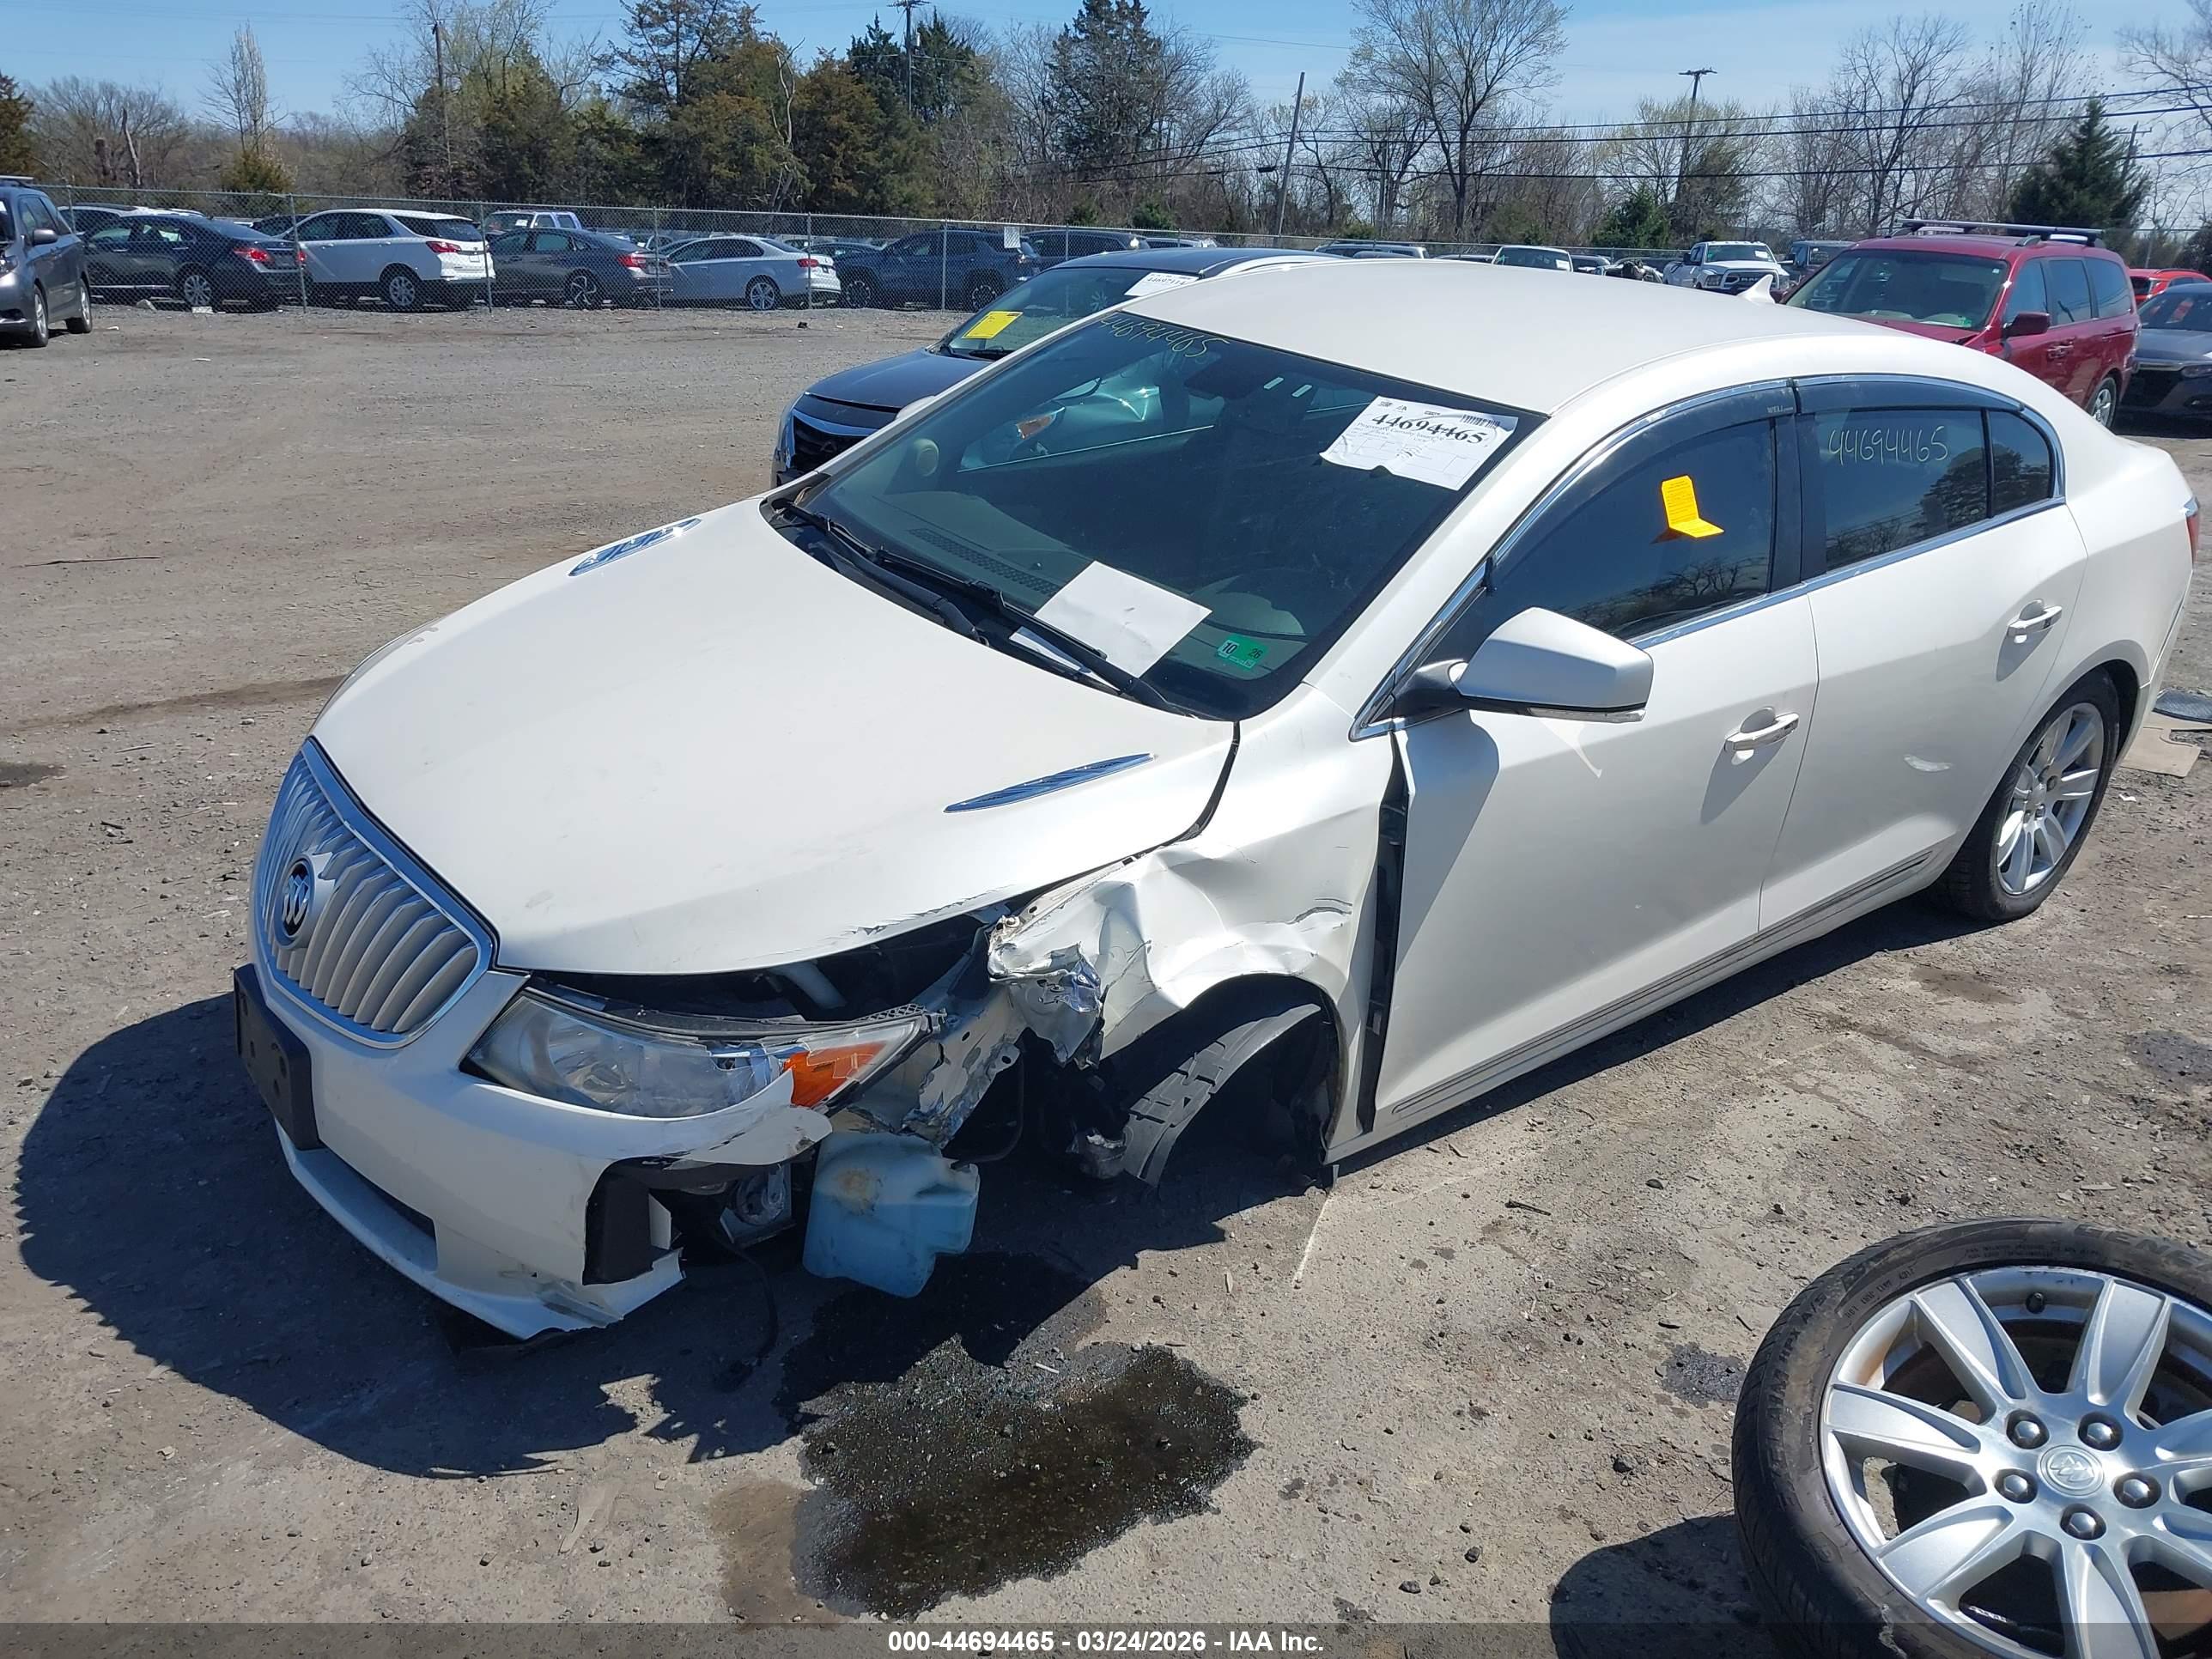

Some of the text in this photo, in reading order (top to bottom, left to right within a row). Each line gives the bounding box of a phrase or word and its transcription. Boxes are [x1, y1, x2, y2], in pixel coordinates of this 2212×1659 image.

[1371, 413, 1488, 444] 44694465
[1828, 425, 1949, 464] 44694465
[1222, 641, 1237, 654] 10
